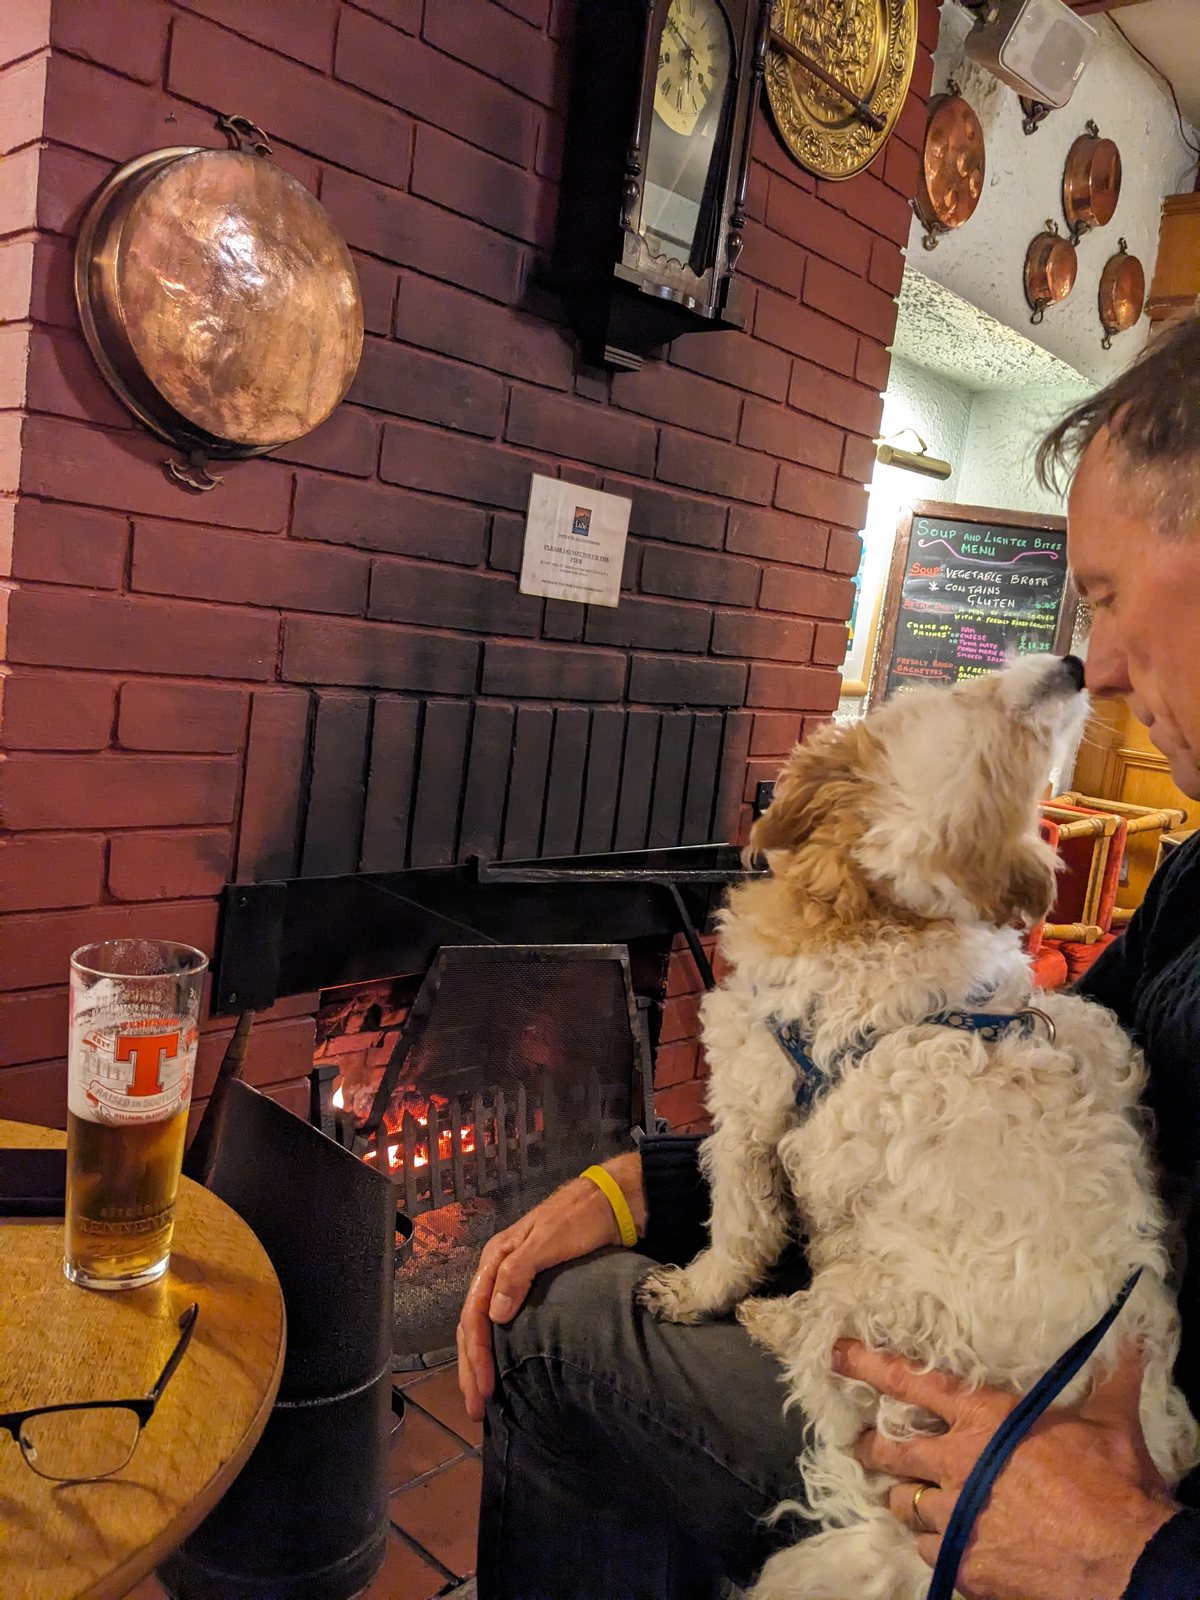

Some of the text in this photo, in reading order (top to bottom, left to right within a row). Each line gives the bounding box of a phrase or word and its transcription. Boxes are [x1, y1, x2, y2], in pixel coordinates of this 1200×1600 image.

[961, 543, 996, 557] MENU
[963, 533, 981, 543] AND
[984, 531, 1027, 547] LIGHTER
[1034, 538, 1063, 551] BITES
[945, 568, 1003, 583] VEGETABLE
[1010, 575, 1049, 587] BROTH
[944, 583, 1001, 595] CONTAINS
[967, 594, 1016, 608] GLUTEN
[114, 1031, 180, 1097] T
[95, 1088, 132, 1108] RAISED
